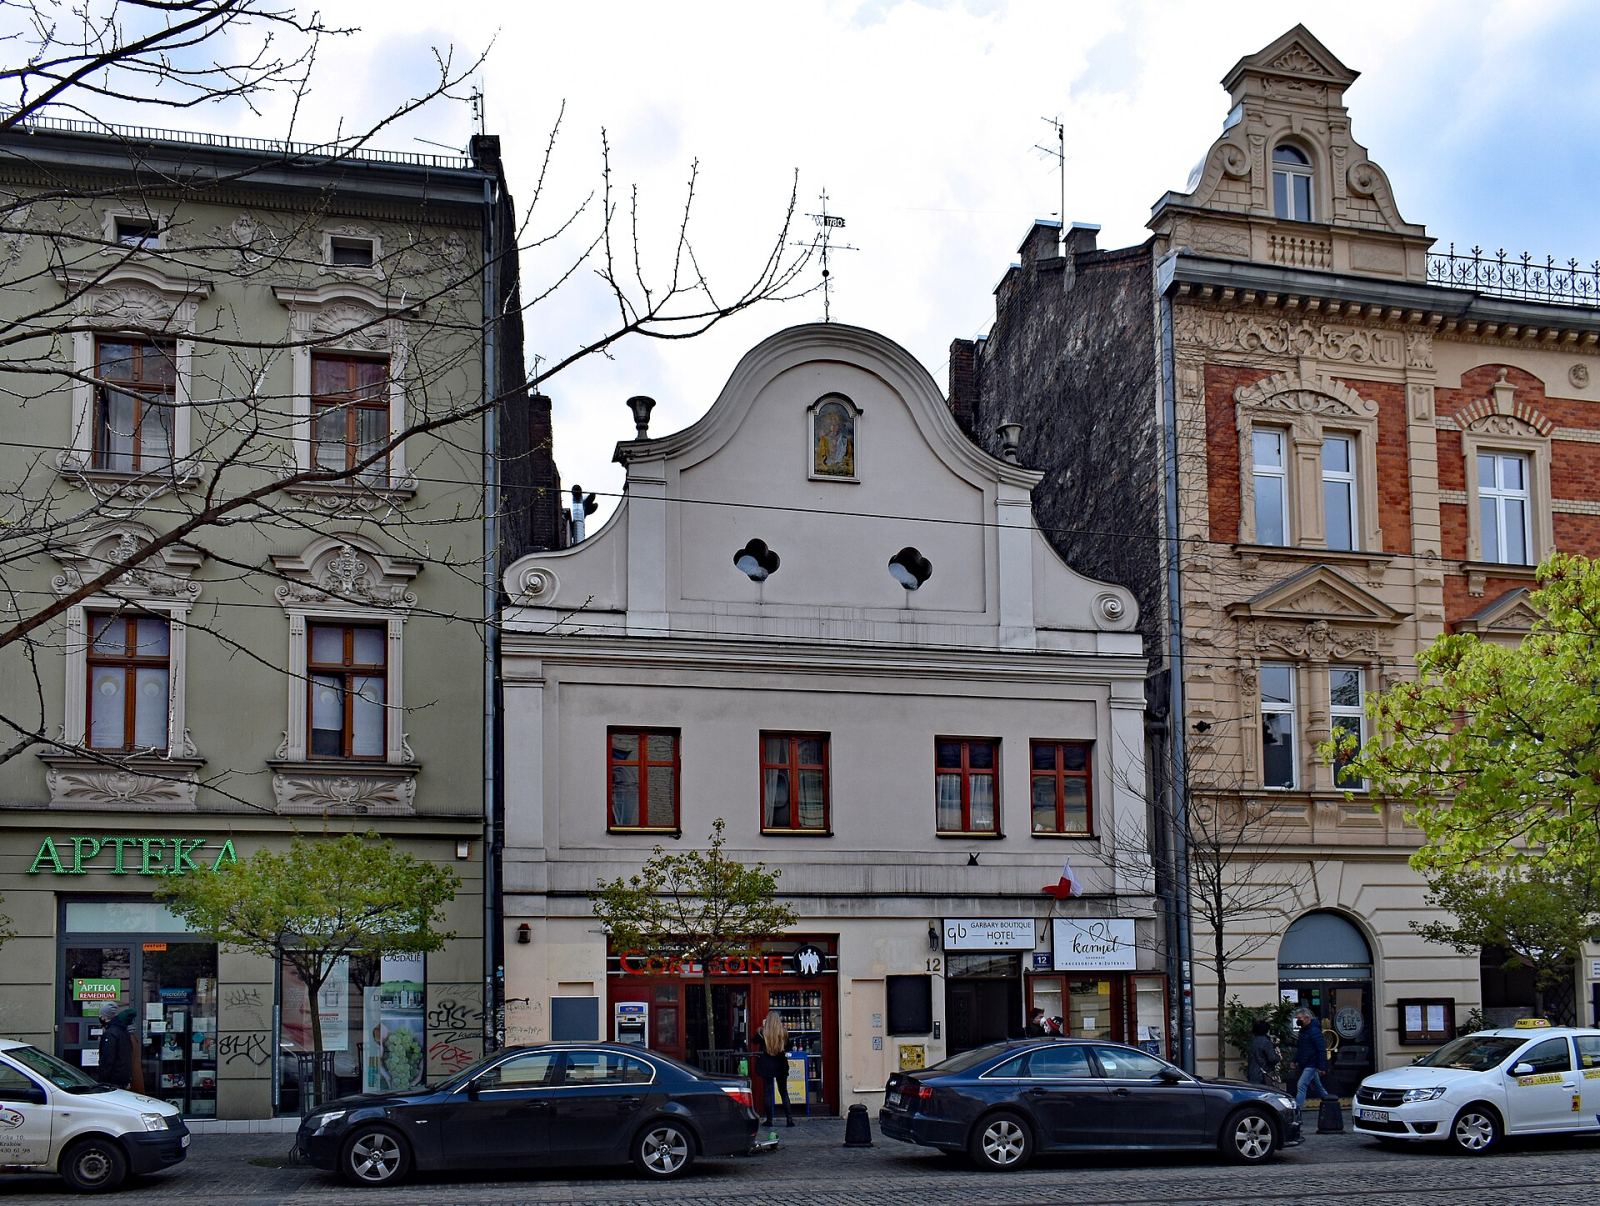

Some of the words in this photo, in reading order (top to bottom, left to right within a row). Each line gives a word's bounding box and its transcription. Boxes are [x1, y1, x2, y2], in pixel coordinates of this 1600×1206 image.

[26, 836, 239, 876] APTEKA
[986, 931, 1016, 940] HOTEL
[1071, 932, 1119, 955] karmel
[1037, 956, 1047, 964] 12
[926, 958, 941, 972] 12
[80, 983, 116, 992] APTEKA
[79, 992, 116, 1000] REMEDIUM
